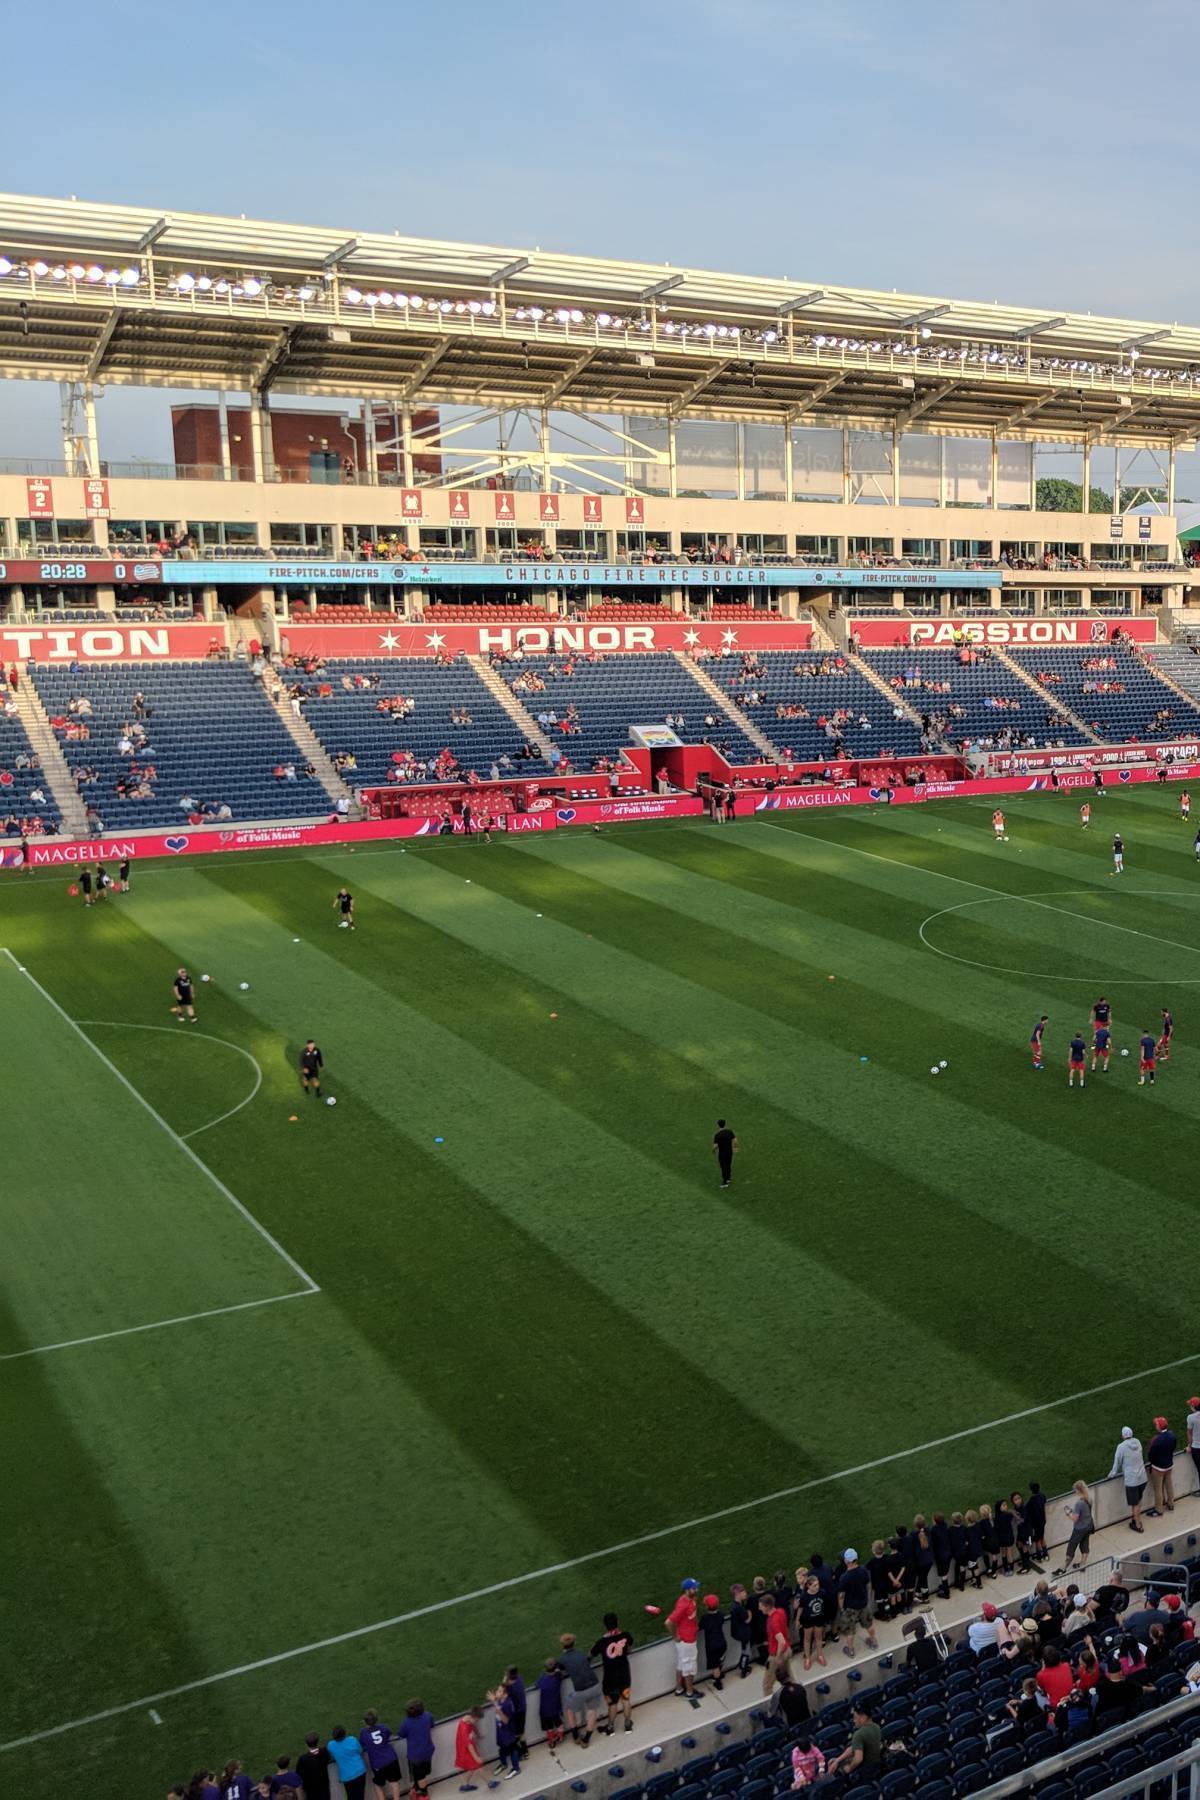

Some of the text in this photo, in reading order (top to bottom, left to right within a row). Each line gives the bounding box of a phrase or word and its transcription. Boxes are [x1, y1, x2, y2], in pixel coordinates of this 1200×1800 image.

[35, 492, 46, 507] 2
[92, 493, 102, 508] 9
[41, 564, 86, 579] 20:28
[115, 564, 126, 579] 0
[506, 568, 766, 582] CHICAGO FIRE REC SOCCER
[478, 627, 656, 651] HONOR
[910, 622, 1077, 643] PASSION
[786, 792, 850, 807] MAGELLAN
[249, 833, 270, 842] Folk
[271, 830, 301, 841] Music
[34, 842, 136, 863] MAGELLAN
[371, 1730, 383, 1744] 5
